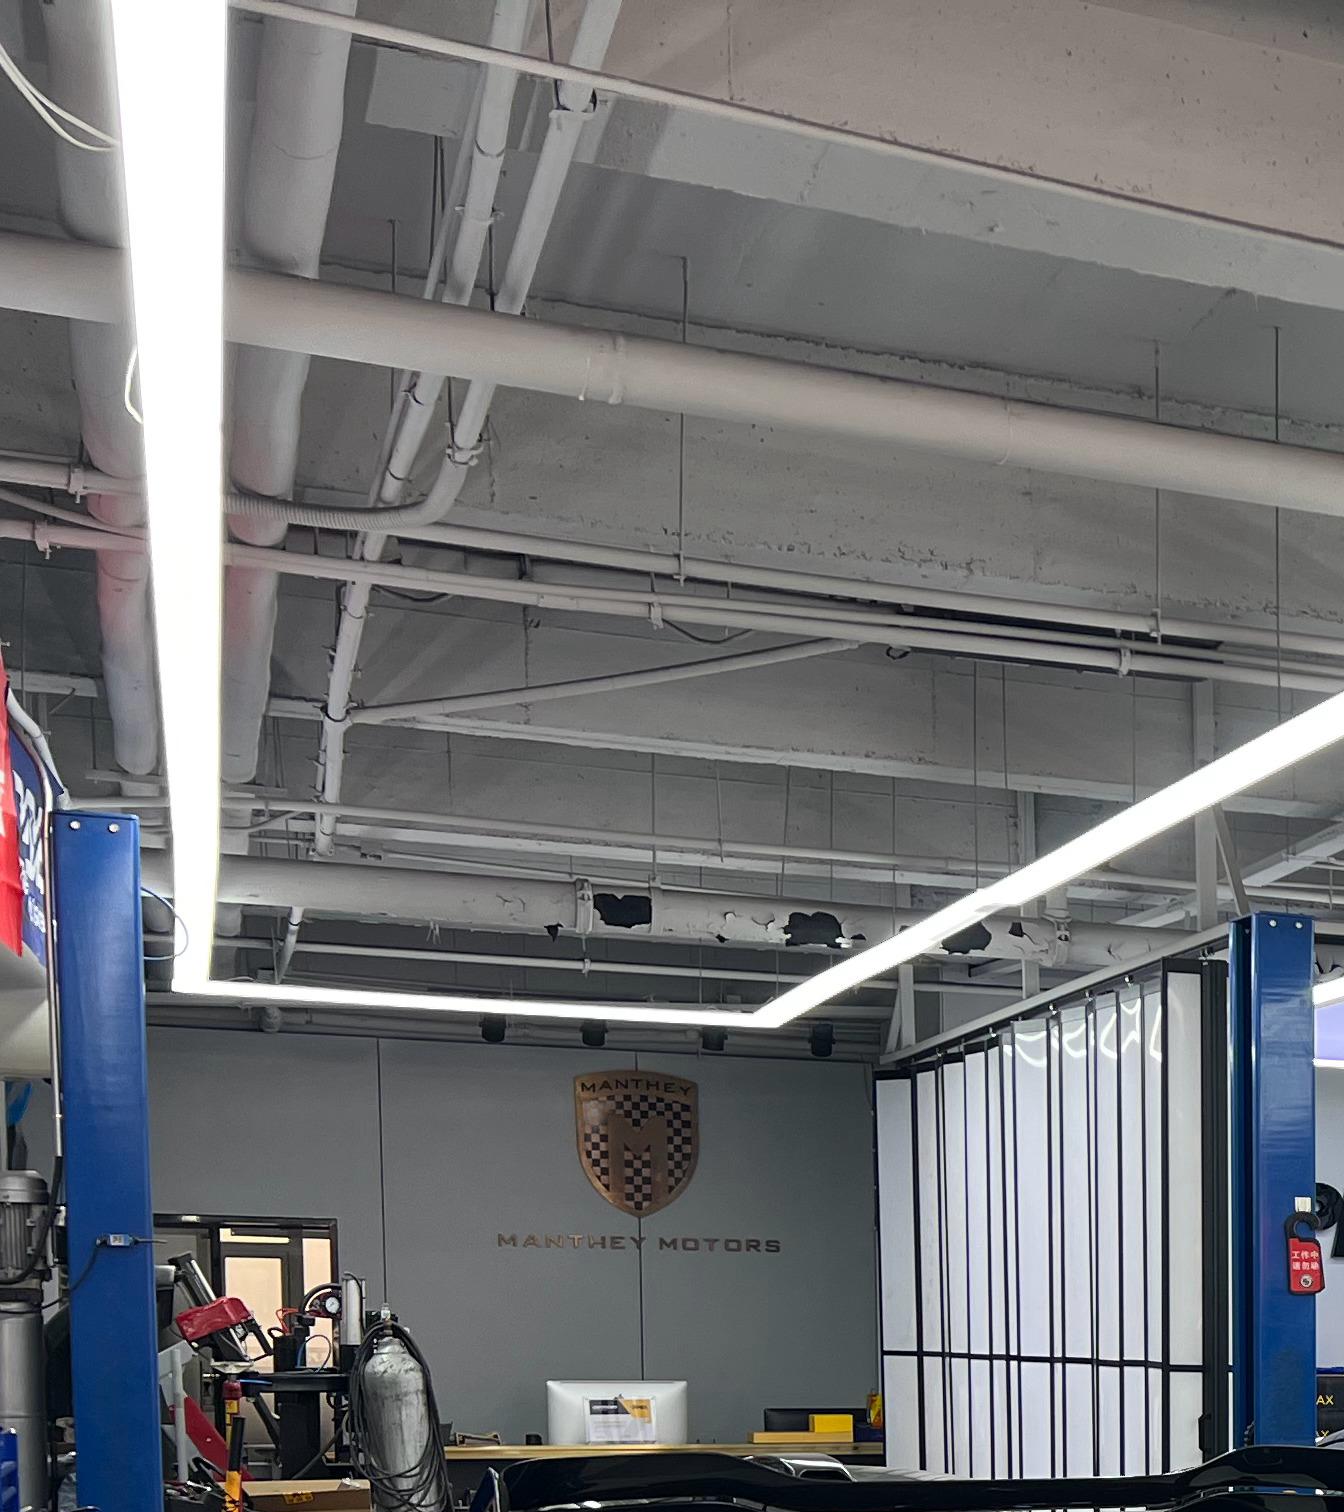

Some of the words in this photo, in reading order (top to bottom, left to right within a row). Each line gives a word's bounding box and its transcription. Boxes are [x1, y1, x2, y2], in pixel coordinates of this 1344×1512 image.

[580, 1078, 693, 1097] MANTHEY
[497, 1233, 647, 1250] MANTHEY
[659, 1236, 781, 1253] MOTORS
[1291, 1250, 1320, 1260] 工作中
